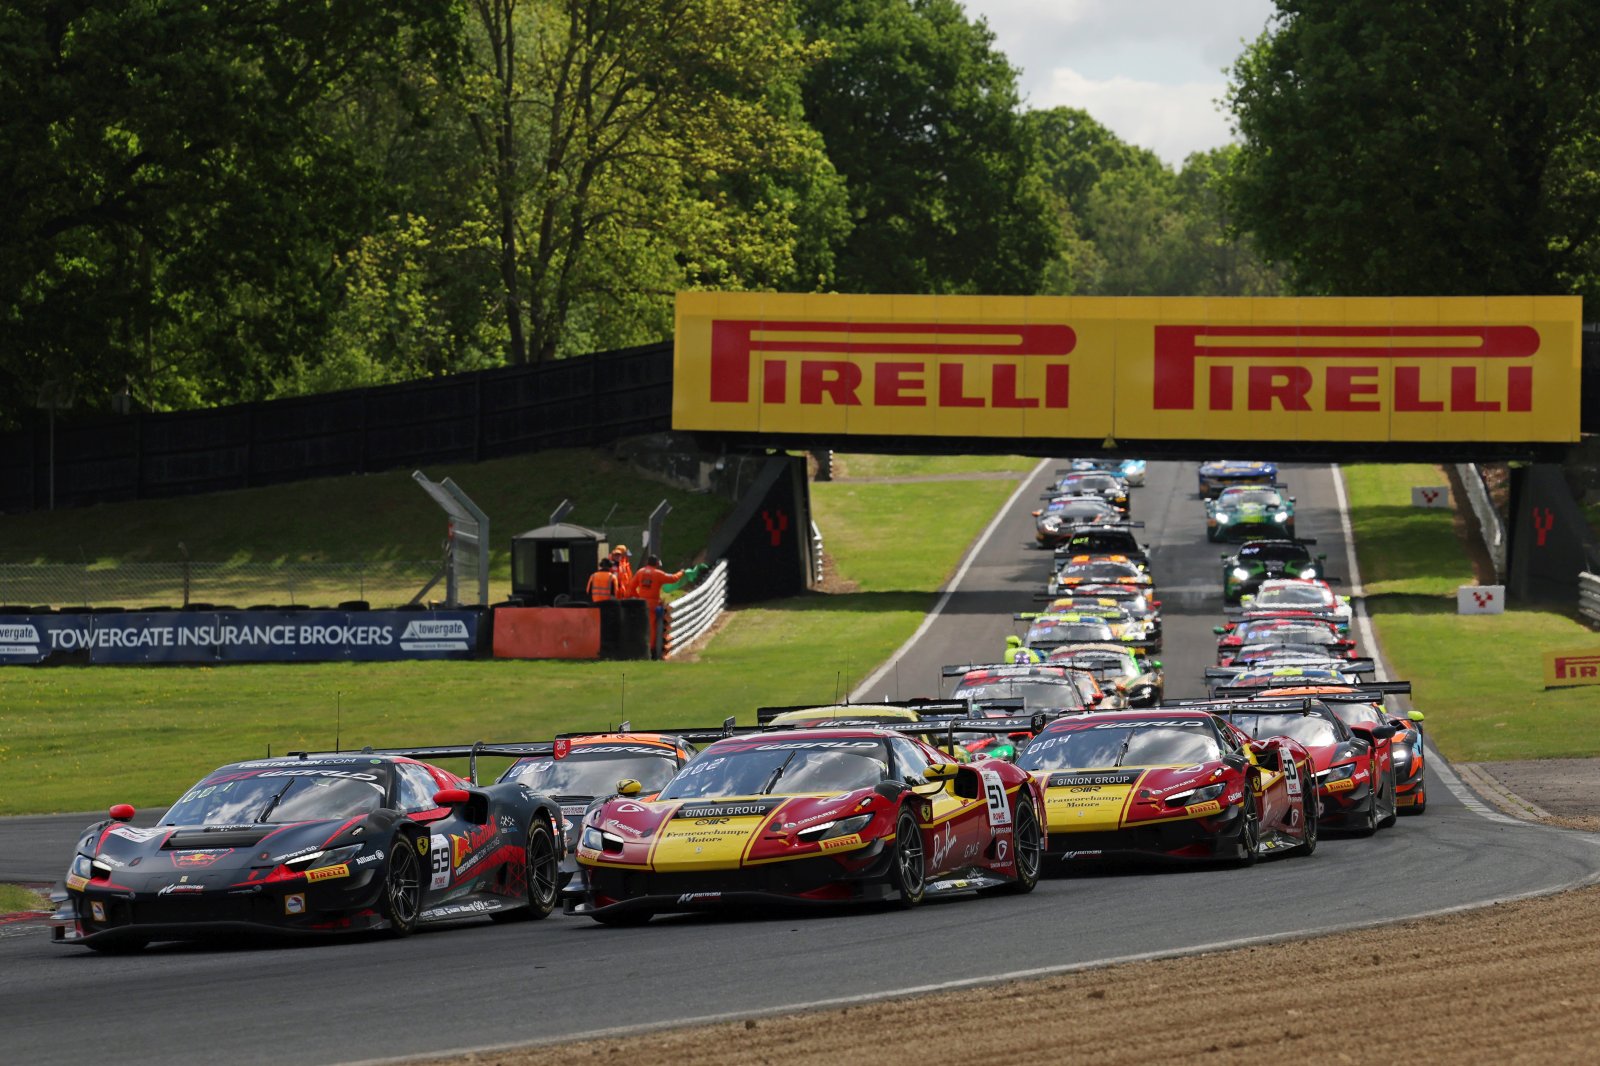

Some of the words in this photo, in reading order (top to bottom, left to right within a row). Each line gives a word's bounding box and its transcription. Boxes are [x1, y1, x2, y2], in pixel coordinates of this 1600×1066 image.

[710, 320, 1076, 409] PIRELLI
[1153, 325, 1540, 412] PIRELLI
[418, 623, 462, 636] towergate
[48, 627, 173, 648] TOWERGATE
[178, 626, 295, 645] INSURANCE
[300, 625, 392, 644] BROKERS
[1095, 721, 1204, 729] WORLD
[571, 746, 677, 757] WORLD
[755, 742, 879, 752] WORLD
[257, 769, 378, 781] WORLD
[675, 758, 727, 780] 002
[1057, 777, 1092, 786] GINION
[1095, 776, 1130, 784] GROUP
[987, 784, 1005, 810] 51
[1047, 795, 1122, 805] Francorchamps
[685, 808, 723, 818] GINION
[726, 805, 766, 815] GROUP
[1190, 802, 1218, 814] PIRELLI
[666, 828, 750, 839] Francorchamps
[685, 836, 723, 844] Motors
[823, 836, 859, 850] PIRELLI
[431, 847, 450, 874] 69
[309, 866, 346, 881] PIRELLI
